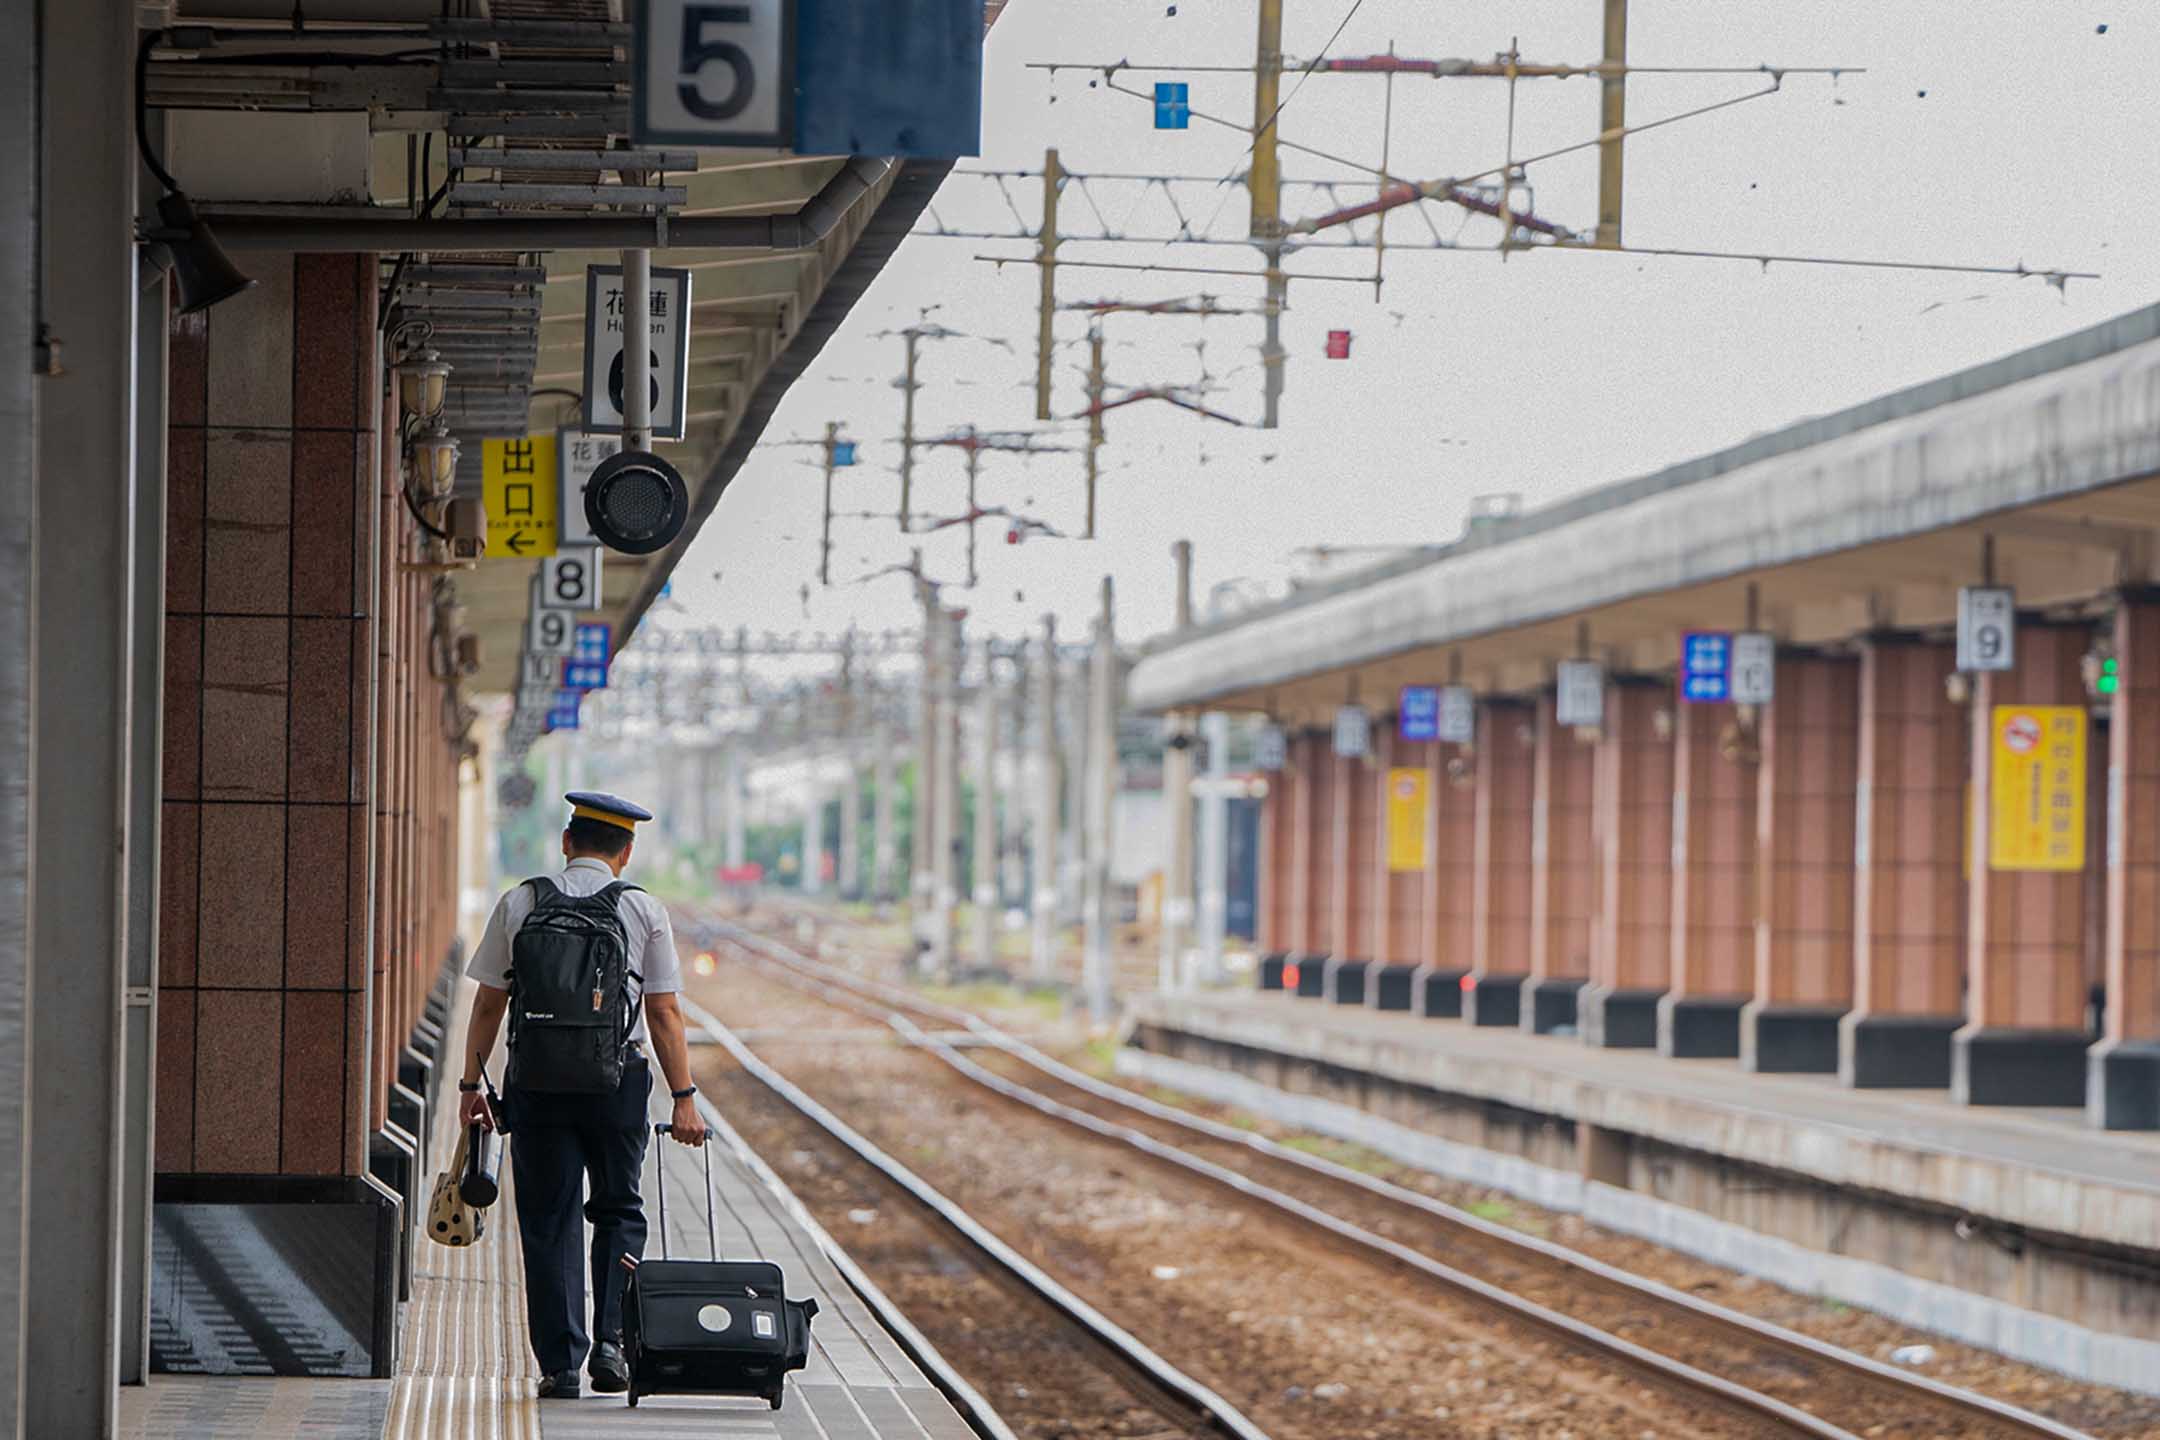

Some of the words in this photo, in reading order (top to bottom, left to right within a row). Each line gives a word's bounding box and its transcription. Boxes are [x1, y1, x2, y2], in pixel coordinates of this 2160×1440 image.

[677, 5, 755, 120] 5
[607, 319, 665, 334] Huen
[608, 347, 659, 418] 6
[504, 439, 534, 516] 出口
[557, 559, 584, 601] 8
[541, 611, 565, 647] 9
[1977, 624, 2003, 659] 9
